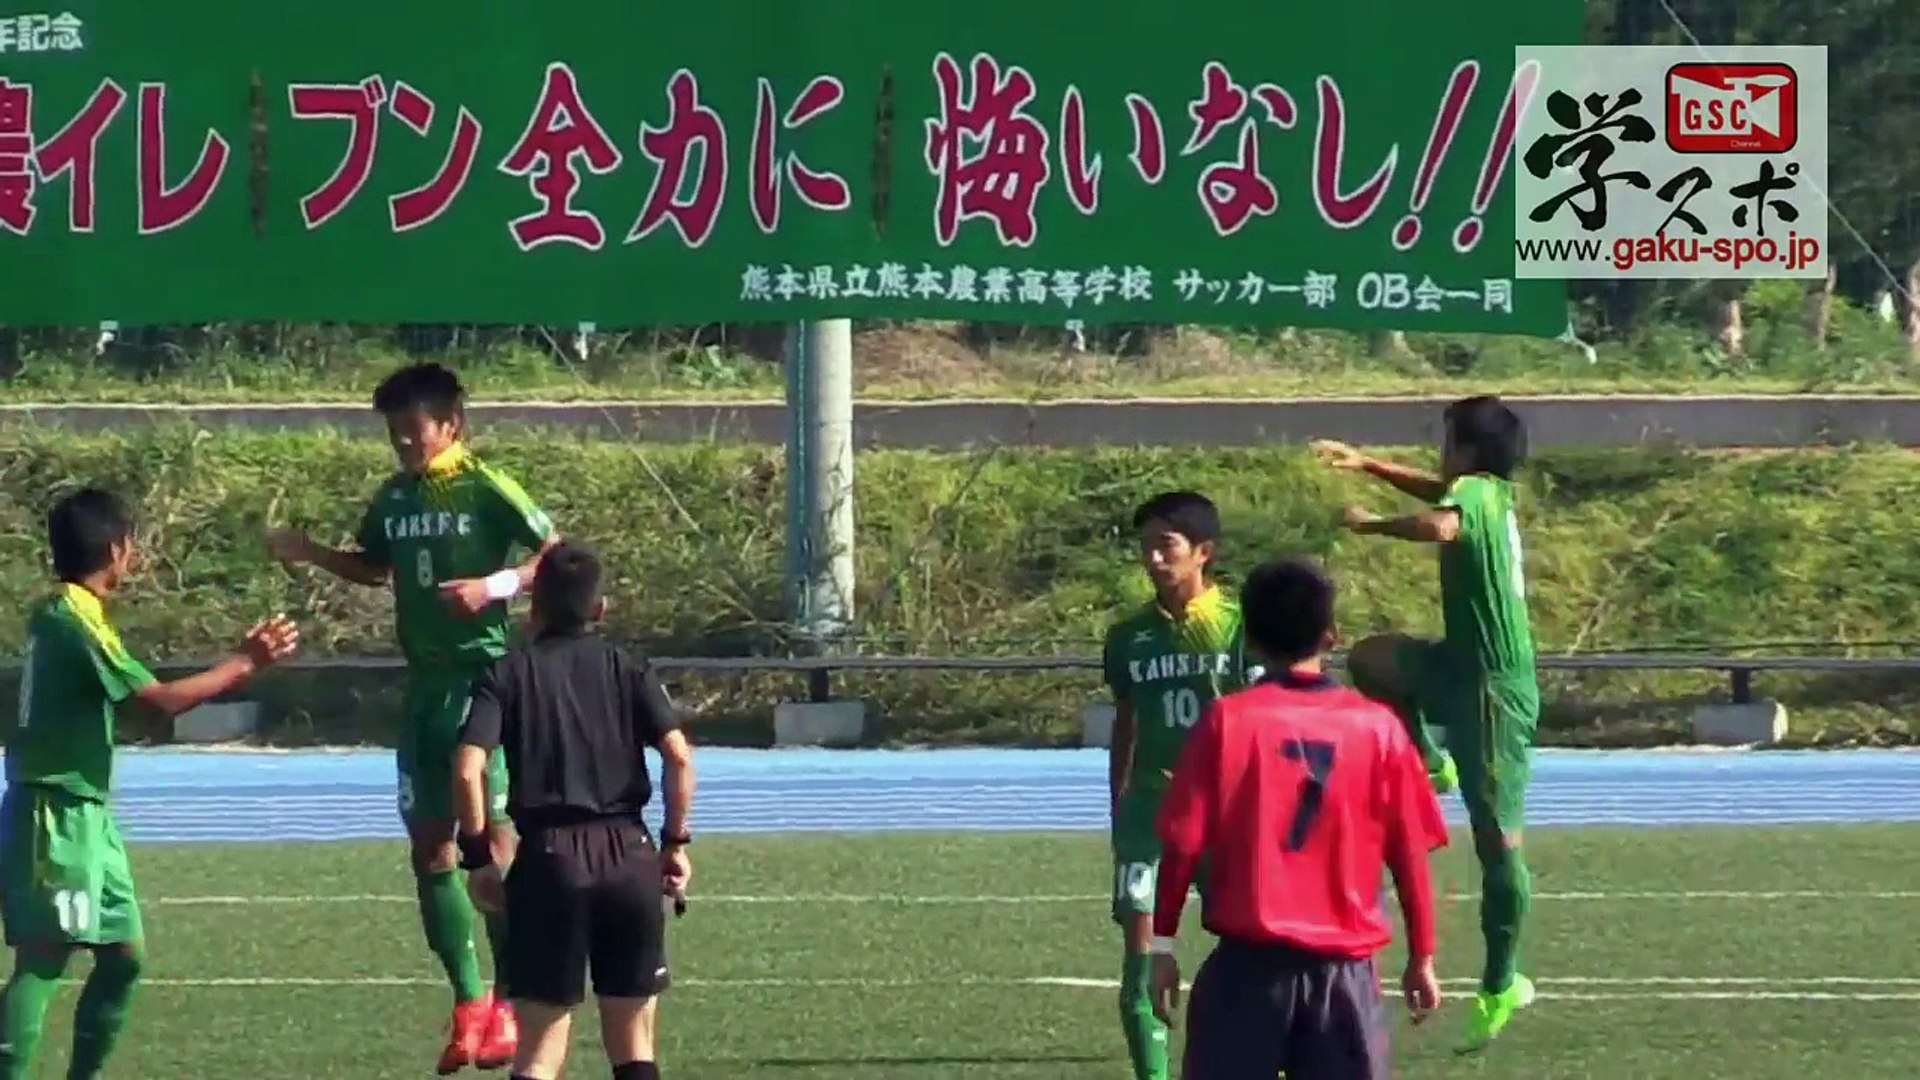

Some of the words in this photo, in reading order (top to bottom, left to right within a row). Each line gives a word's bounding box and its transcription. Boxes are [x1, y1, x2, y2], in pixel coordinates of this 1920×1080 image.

[739, 261, 1152, 308] 熊本県立熊本農業高等学校
[1172, 267, 1338, 309] サッカー部
[1356, 272, 1512, 313] OB会一同
[417, 549, 433, 588] 8
[1162, 688, 1198, 727] 10
[1280, 739, 1336, 852] 7
[55, 889, 89, 931] 11
